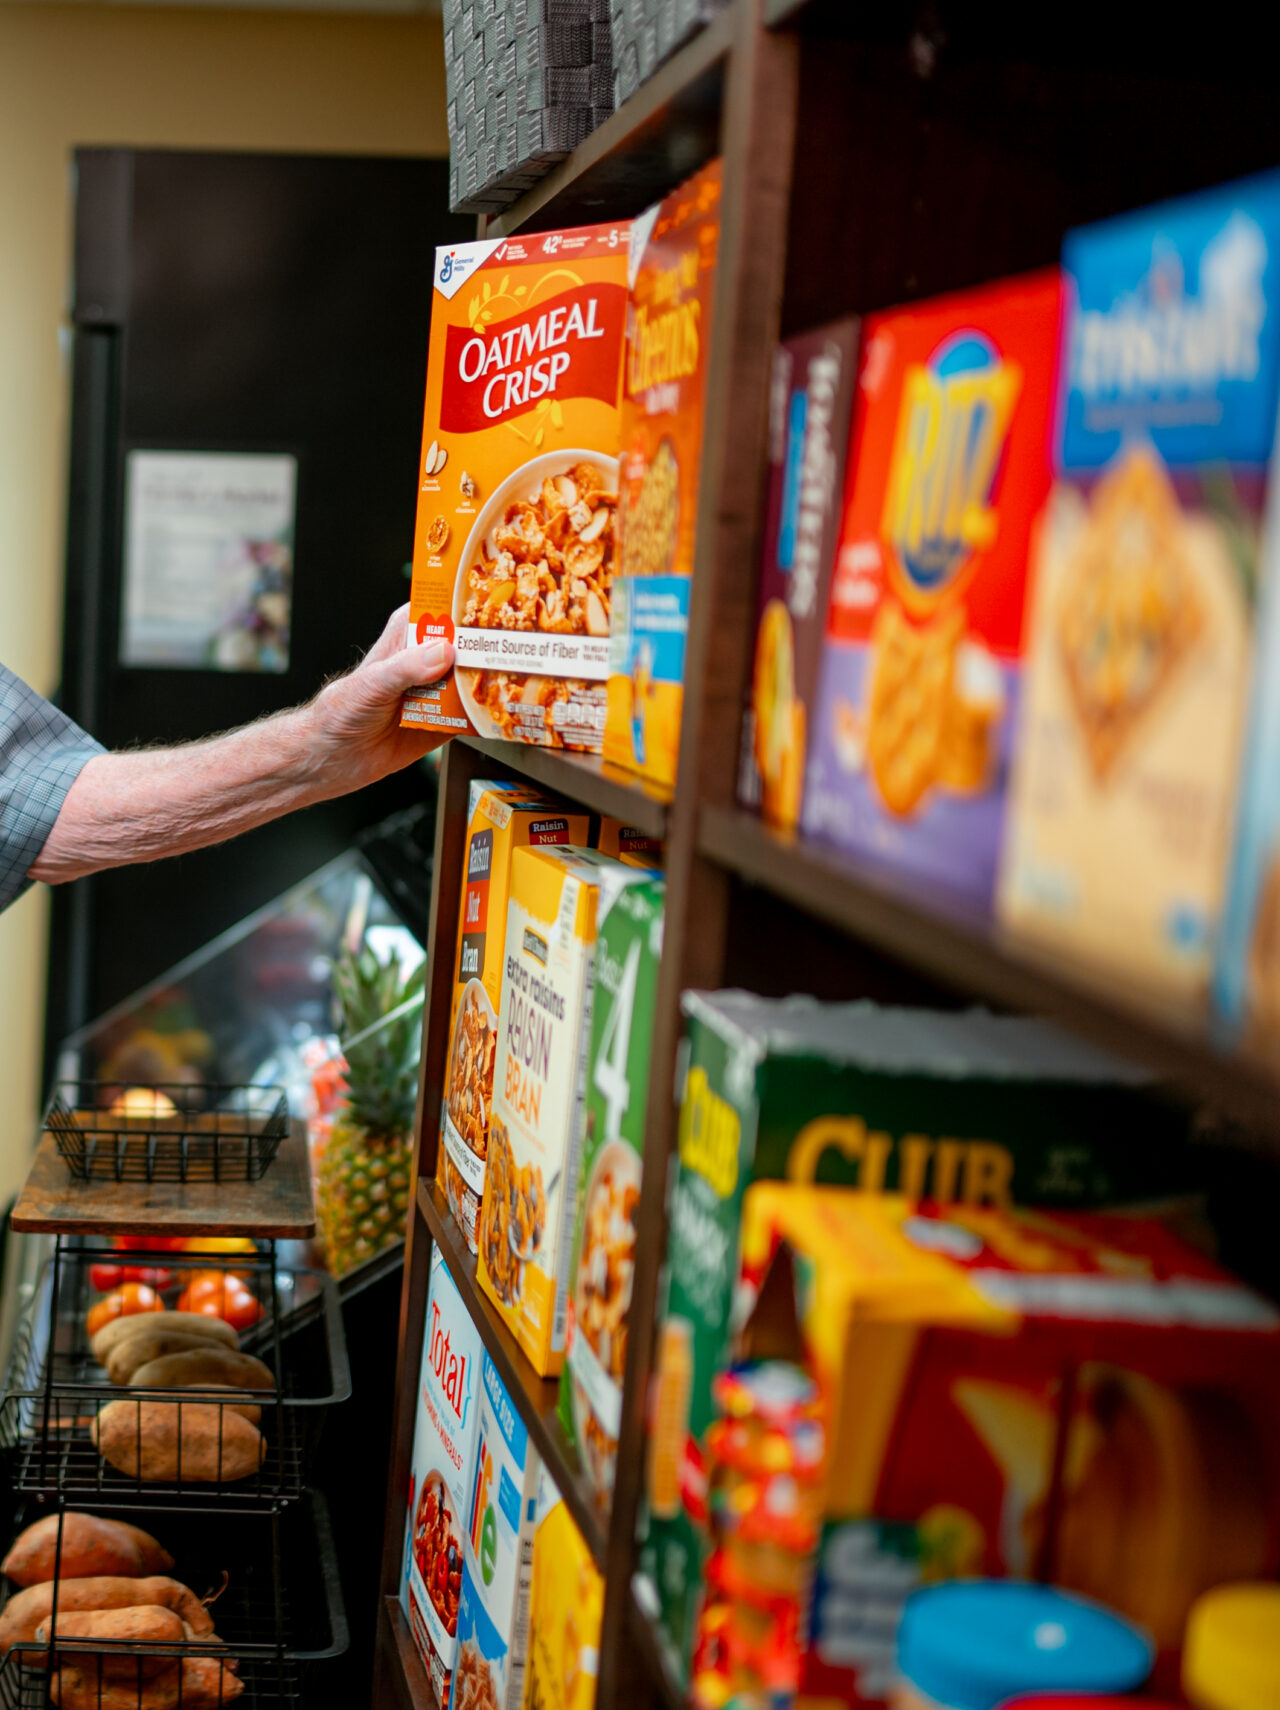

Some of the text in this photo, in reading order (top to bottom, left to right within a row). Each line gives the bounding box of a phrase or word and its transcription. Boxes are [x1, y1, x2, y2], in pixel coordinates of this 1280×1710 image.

[459, 299, 604, 383] OATMEAL
[482, 352, 571, 418] CRISP
[426, 625, 445, 635] HEART
[457, 636, 579, 659] Excellent Source of Fiber
[533, 822, 564, 833] Raisin
[539, 835, 557, 843] Nut
[629, 841, 648, 850] Nut
[469, 838, 490, 875] Raisin
[467, 891, 481, 923] Nut
[462, 941, 479, 973] Bran
[507, 955, 566, 1021] extra raisins
[507, 988, 553, 1083] RAISIN
[504, 1053, 542, 1127] BRAN
[429, 1299, 466, 1420] Total
[484, 1356, 503, 1410] LARGE
[499, 1398, 515, 1442] SIZE
